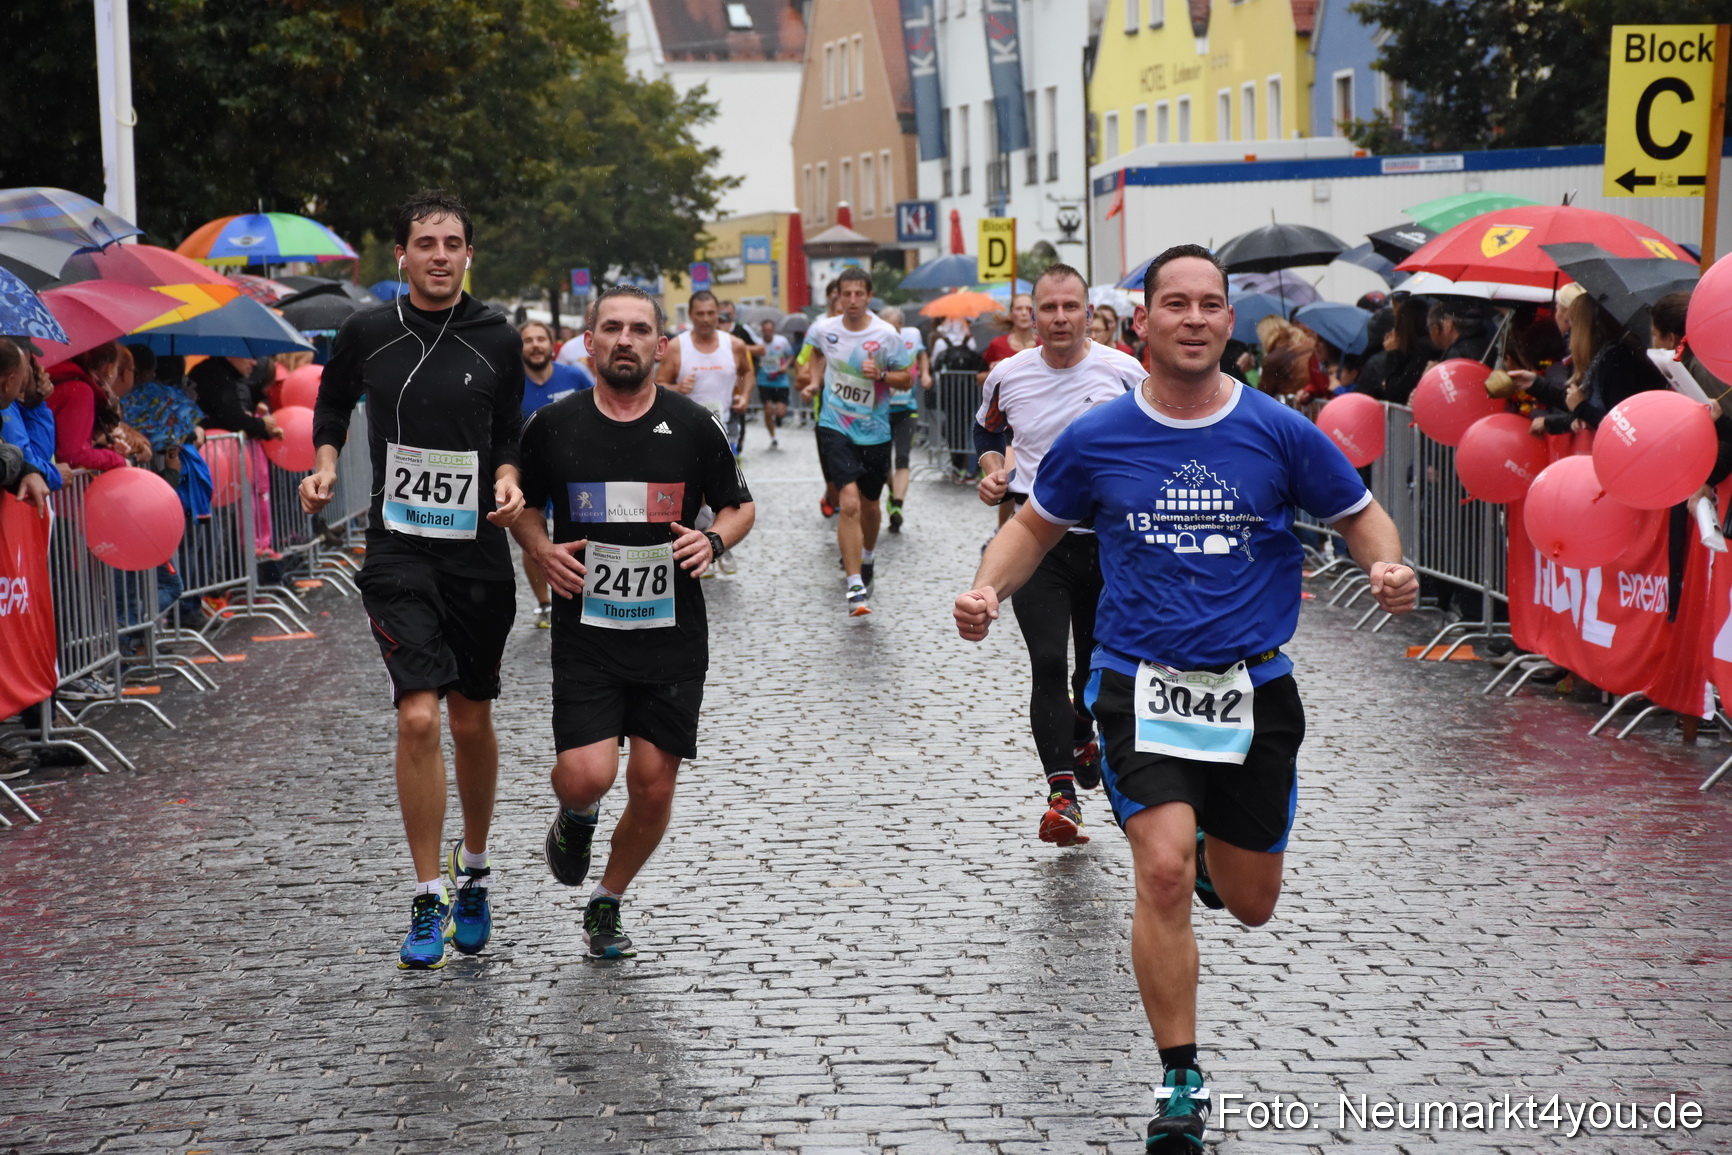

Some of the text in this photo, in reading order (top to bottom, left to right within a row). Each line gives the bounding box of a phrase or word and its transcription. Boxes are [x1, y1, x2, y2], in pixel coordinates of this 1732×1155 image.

[1625, 33, 1714, 63] Block
[1635, 76, 1695, 161] C
[901, 204, 934, 236] KL
[983, 220, 1012, 232] Block
[988, 238, 1007, 268] D
[834, 383, 871, 404] 2067
[428, 453, 473, 465] BOCK
[394, 467, 473, 505] 2457
[406, 508, 455, 526] Michael
[608, 504, 645, 516] MÜLLER
[1126, 512, 1265, 532] 13. Neumarkter Stadtlau
[627, 547, 669, 560] BOCK
[593, 564, 668, 598] 2478
[604, 603, 655, 618] Thorsten
[1148, 676, 1243, 723] 3042
